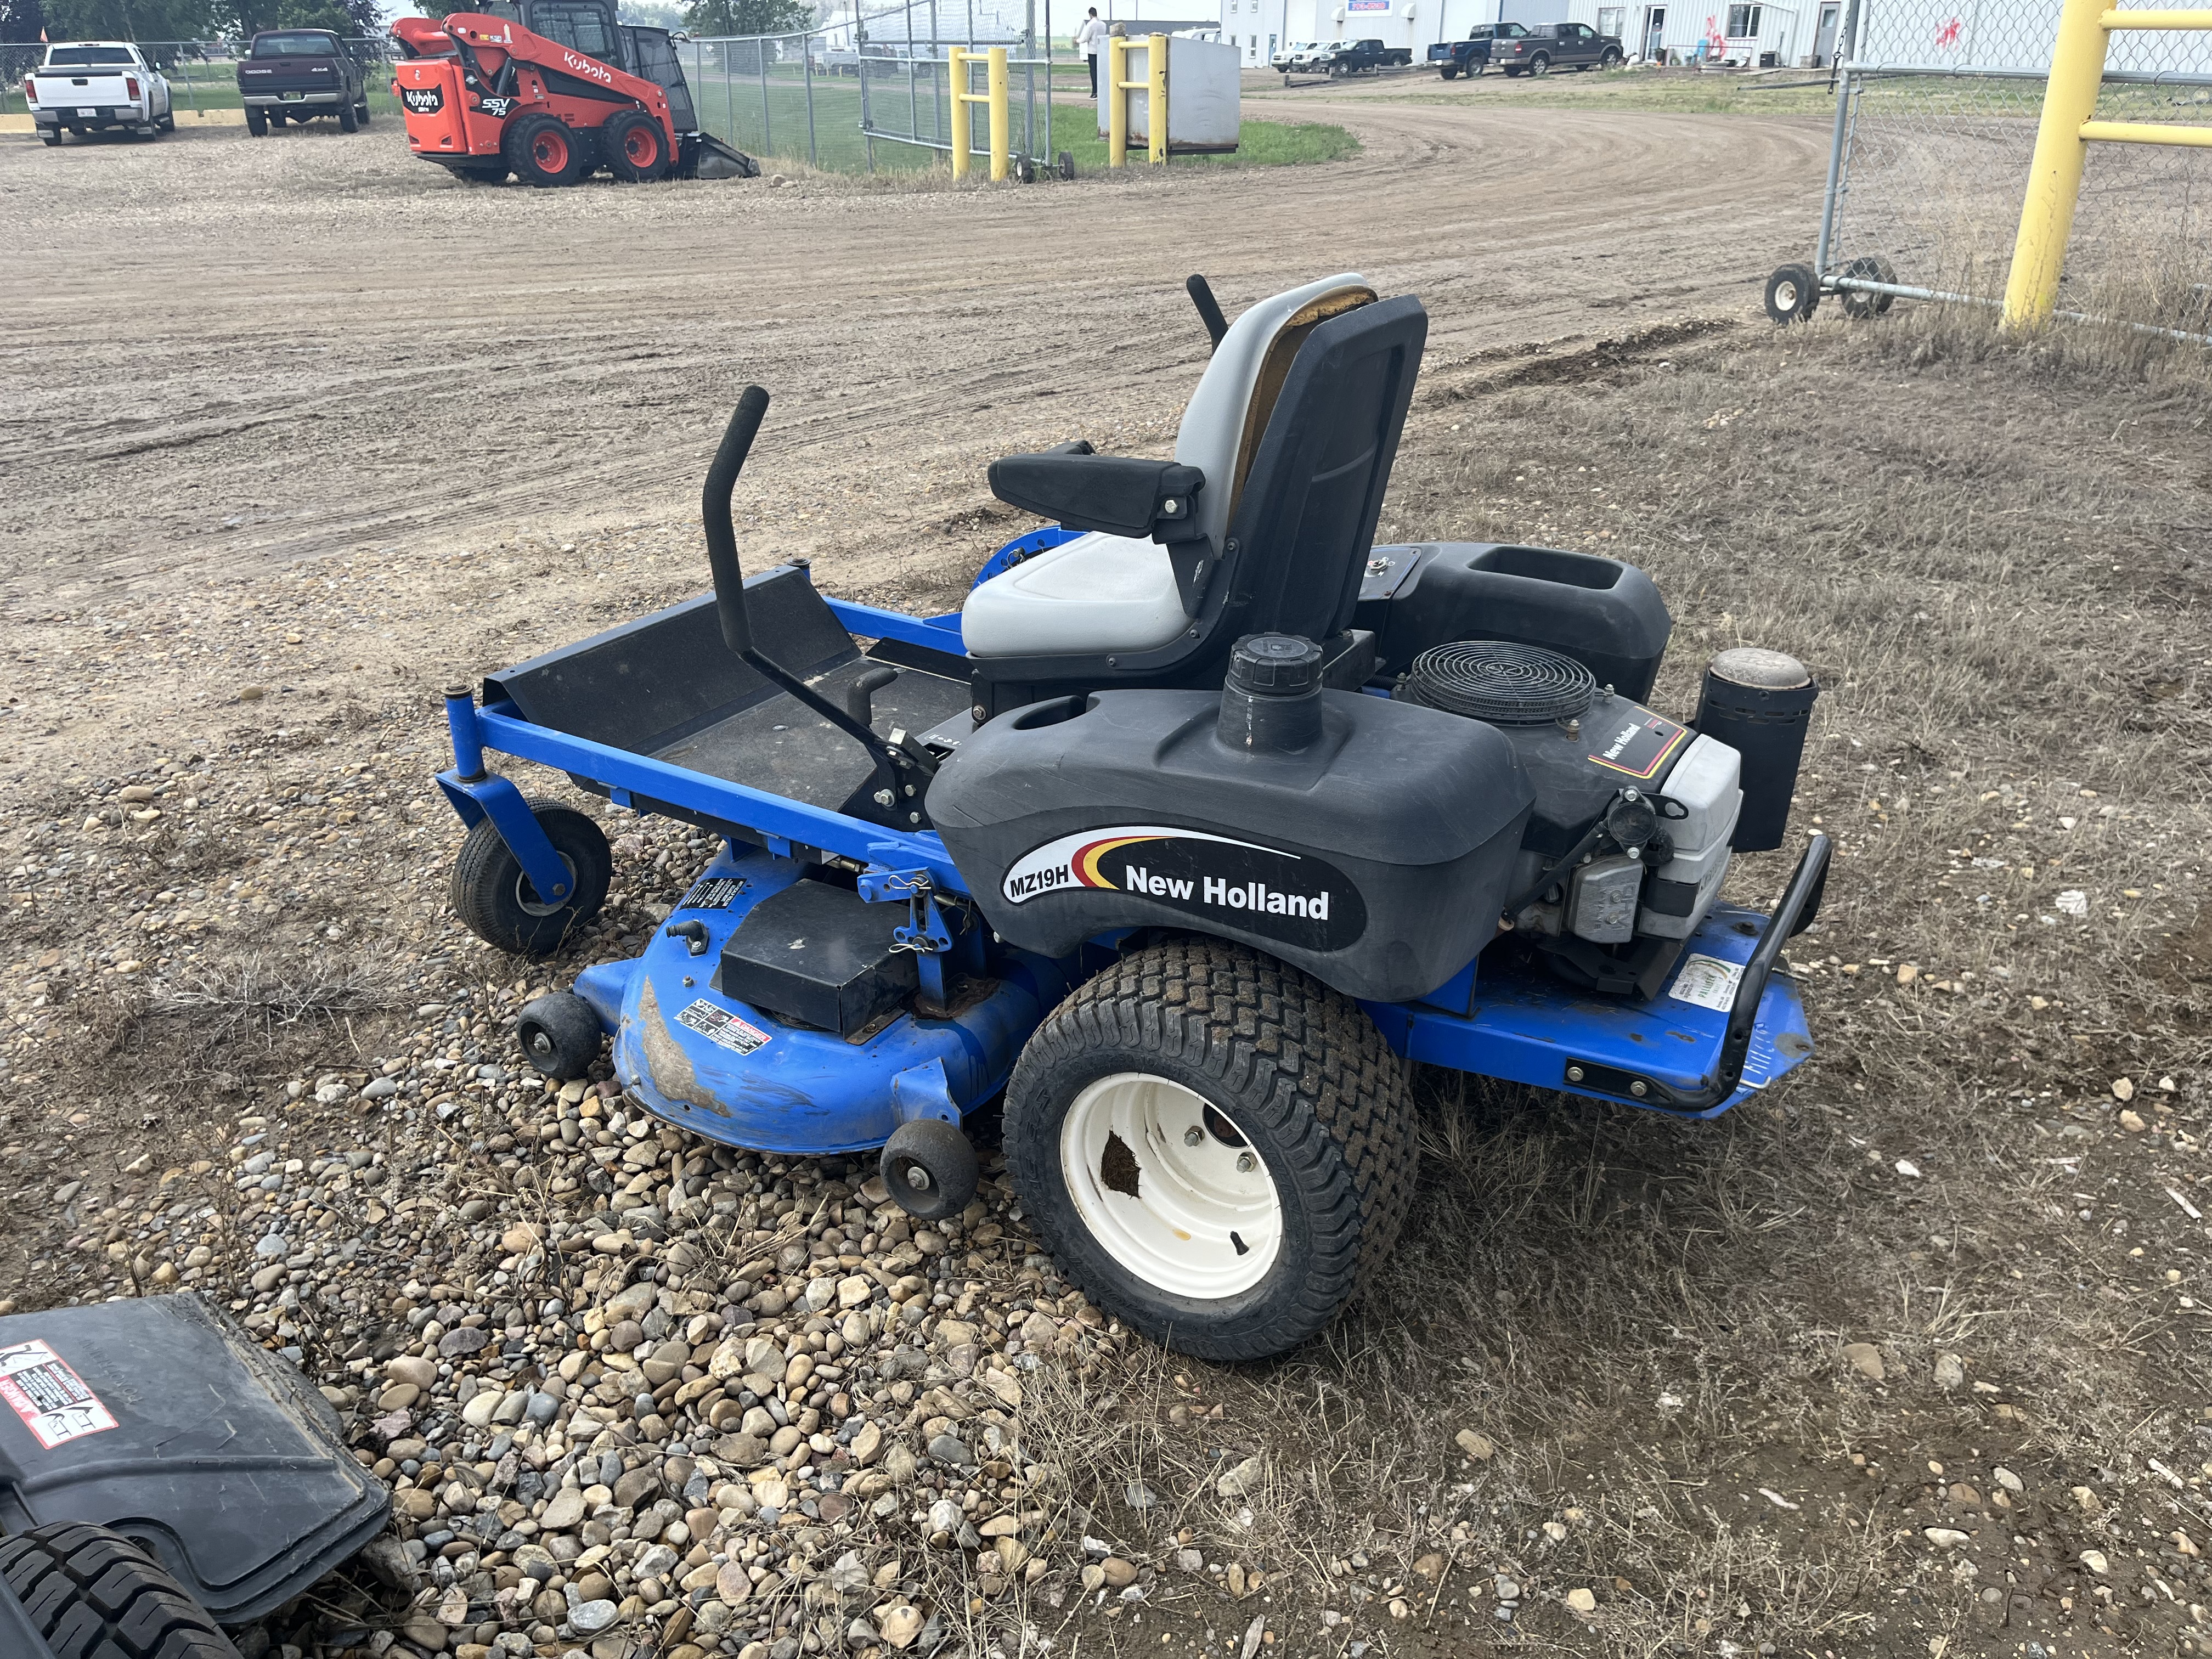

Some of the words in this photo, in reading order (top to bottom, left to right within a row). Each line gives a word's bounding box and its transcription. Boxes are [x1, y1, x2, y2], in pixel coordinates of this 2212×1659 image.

[564, 52, 611, 83] Kubota
[406, 91, 438, 106] Kubota
[482, 98, 511, 108] SSV
[492, 108, 506, 116] 75
[1602, 743, 1624, 760] New
[1614, 723, 1641, 746] Holland
[1010, 864, 1069, 898] MZ19H
[1126, 865, 1194, 900] New
[1203, 876, 1329, 921] Holland
[742, 1024, 767, 1040] DANGER
[1, 1379, 27, 1409] DANGER
